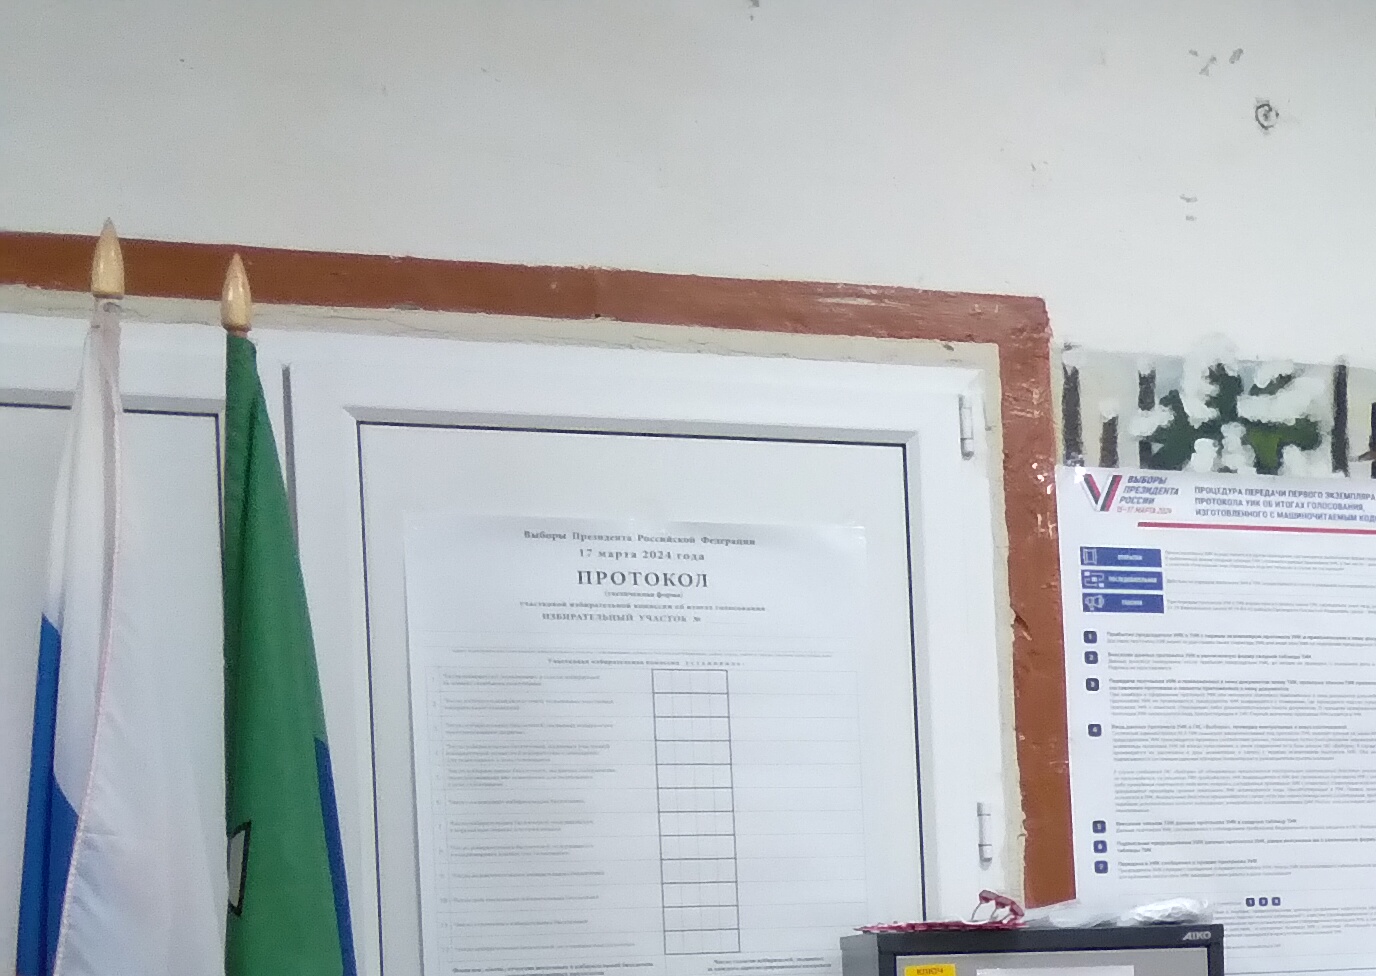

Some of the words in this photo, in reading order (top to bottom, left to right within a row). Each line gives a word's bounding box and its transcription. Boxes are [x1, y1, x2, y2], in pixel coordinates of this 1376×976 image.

[1128, 476, 1168, 484] ВЫБОРЫ
[1123, 486, 1179, 495] ПРЕЗИДЕНТА
[1194, 486, 1243, 496] ПРОЦЕДУРА
[1245, 488, 1286, 498] ПЕРЕДАЧИ
[1288, 489, 1323, 499] ПЕРВОГО
[1119, 496, 1156, 505] РОССИИ
[1194, 498, 1243, 507] ПРОТОКОЛА
[524, 530, 567, 541] Выборы
[572, 532, 632, 543] Президента
[637, 534, 696, 544] Российской
[579, 548, 593, 558] 17
[598, 550, 637, 561] марта
[642, 550, 672, 560] 2024
[677, 553, 705, 562] года
[577, 570, 709, 588] ПРОТОКОЛ
[1183, 930, 1212, 941] AIKO
